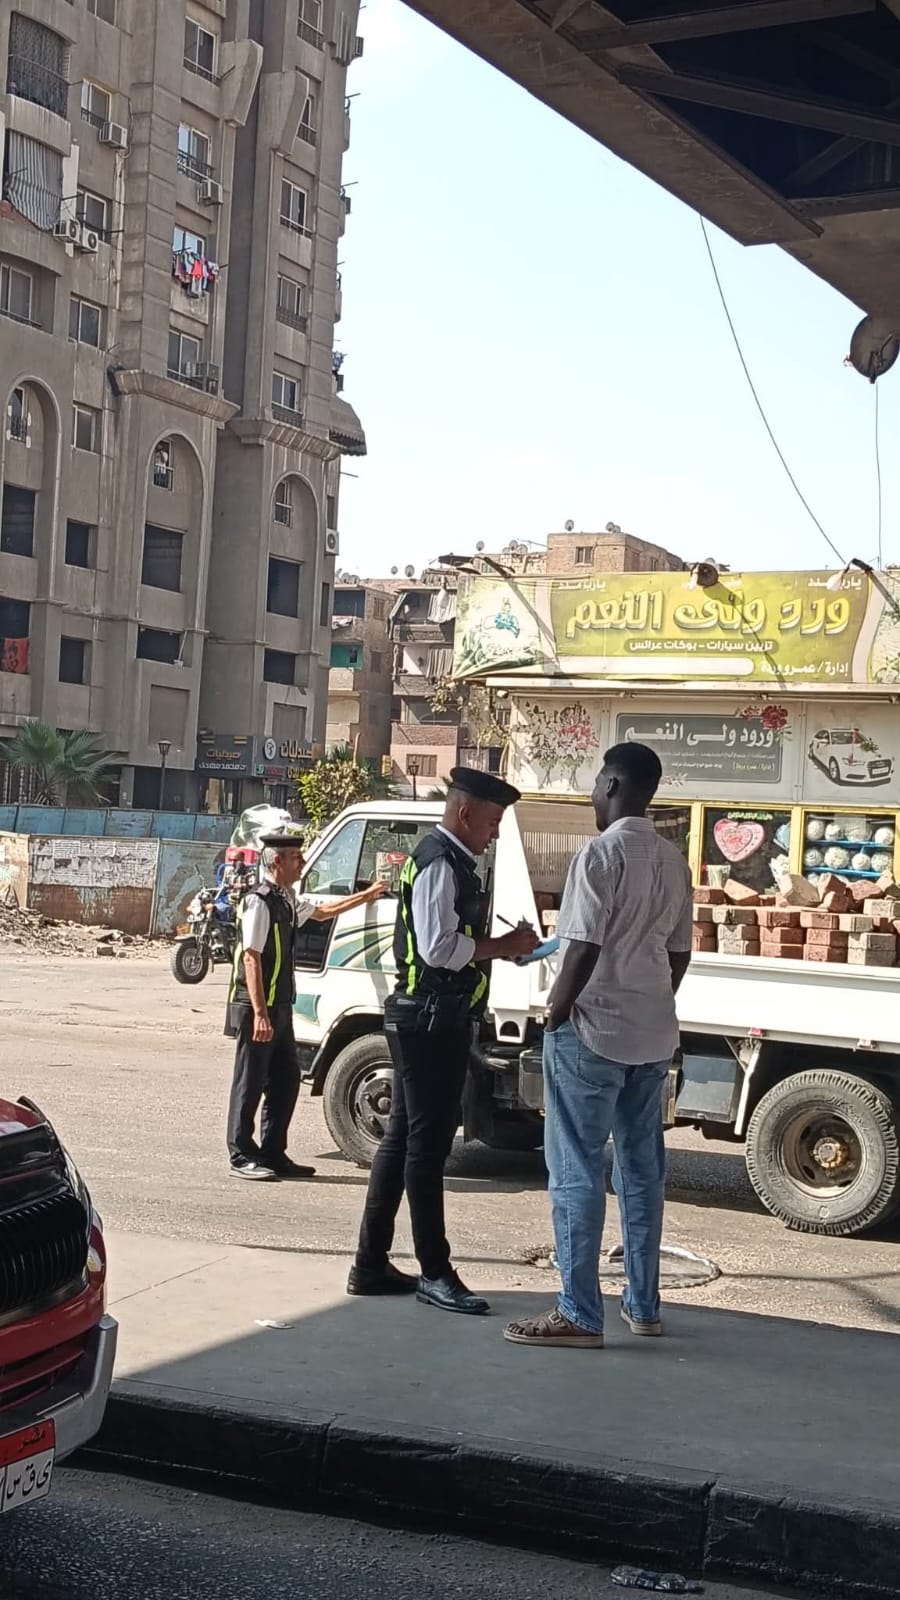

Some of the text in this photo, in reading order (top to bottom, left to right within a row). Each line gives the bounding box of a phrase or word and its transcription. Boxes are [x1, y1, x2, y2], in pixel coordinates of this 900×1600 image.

[565, 590, 850, 638] ورد ولى النعم
[629, 640, 663, 651] عرائس
[664, 640, 697, 652] بوكات
[706, 640, 745, 651] سيارات
[746, 640, 773, 652] تزيين
[825, 660, 849, 677] إدارة
[624, 722, 774, 748] ورود ولى النعم
[18, 1428, 44, 1452] مصر
